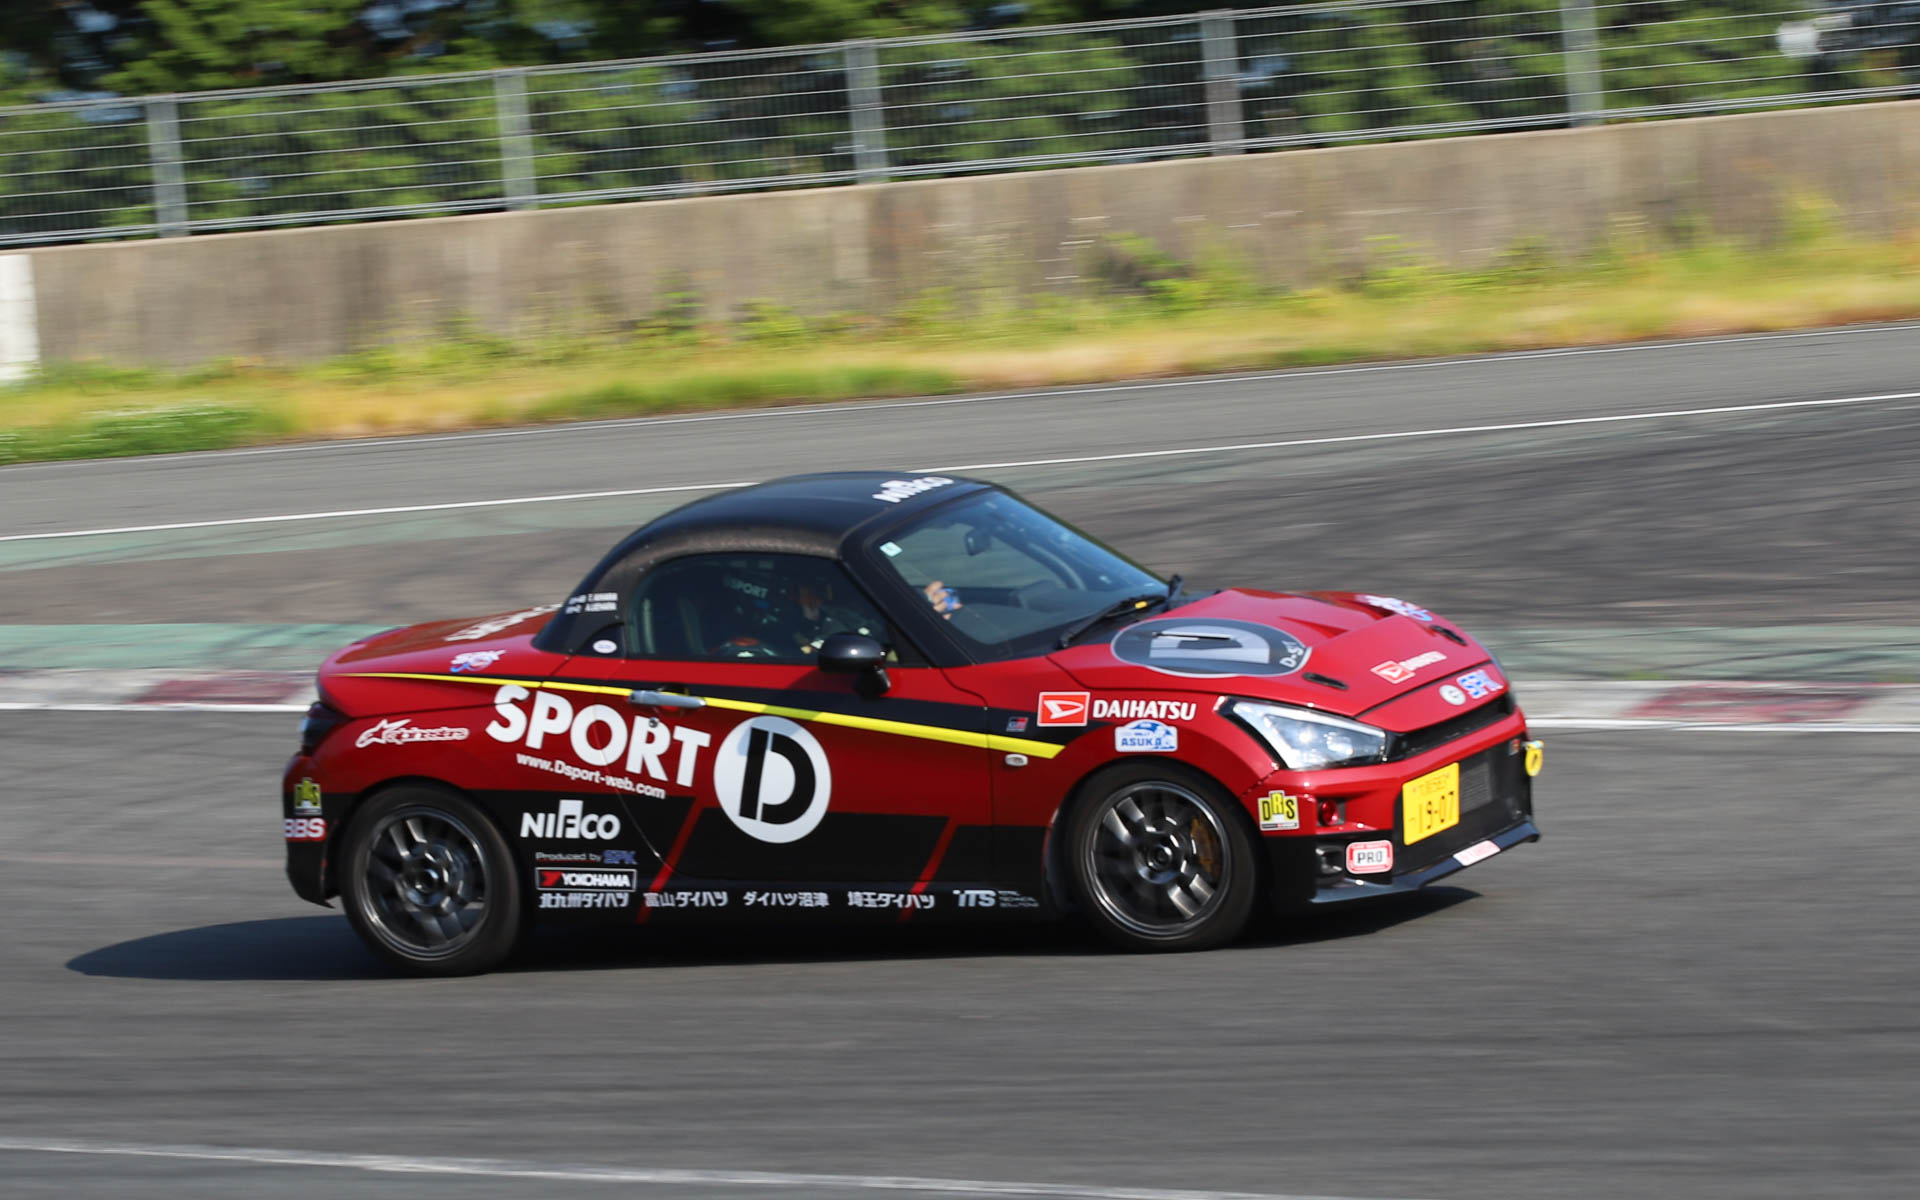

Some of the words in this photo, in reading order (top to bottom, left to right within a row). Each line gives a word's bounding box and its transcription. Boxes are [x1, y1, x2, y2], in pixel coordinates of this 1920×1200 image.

[1092, 699, 1197, 721] DAIHATSU
[485, 684, 711, 787] SPORT
[517, 753, 666, 799] www.Dsport-web.com
[520, 799, 621, 840] NIFCO
[1262, 793, 1296, 821] DRS
[1418, 790, 1456, 834] 19-07
[1357, 851, 1383, 864] PRO
[562, 873, 631, 887] YOKOHAMA
[742, 891, 829, 907] ダイハツ沼津
[847, 891, 936, 909] 埼玉ダイハツ
